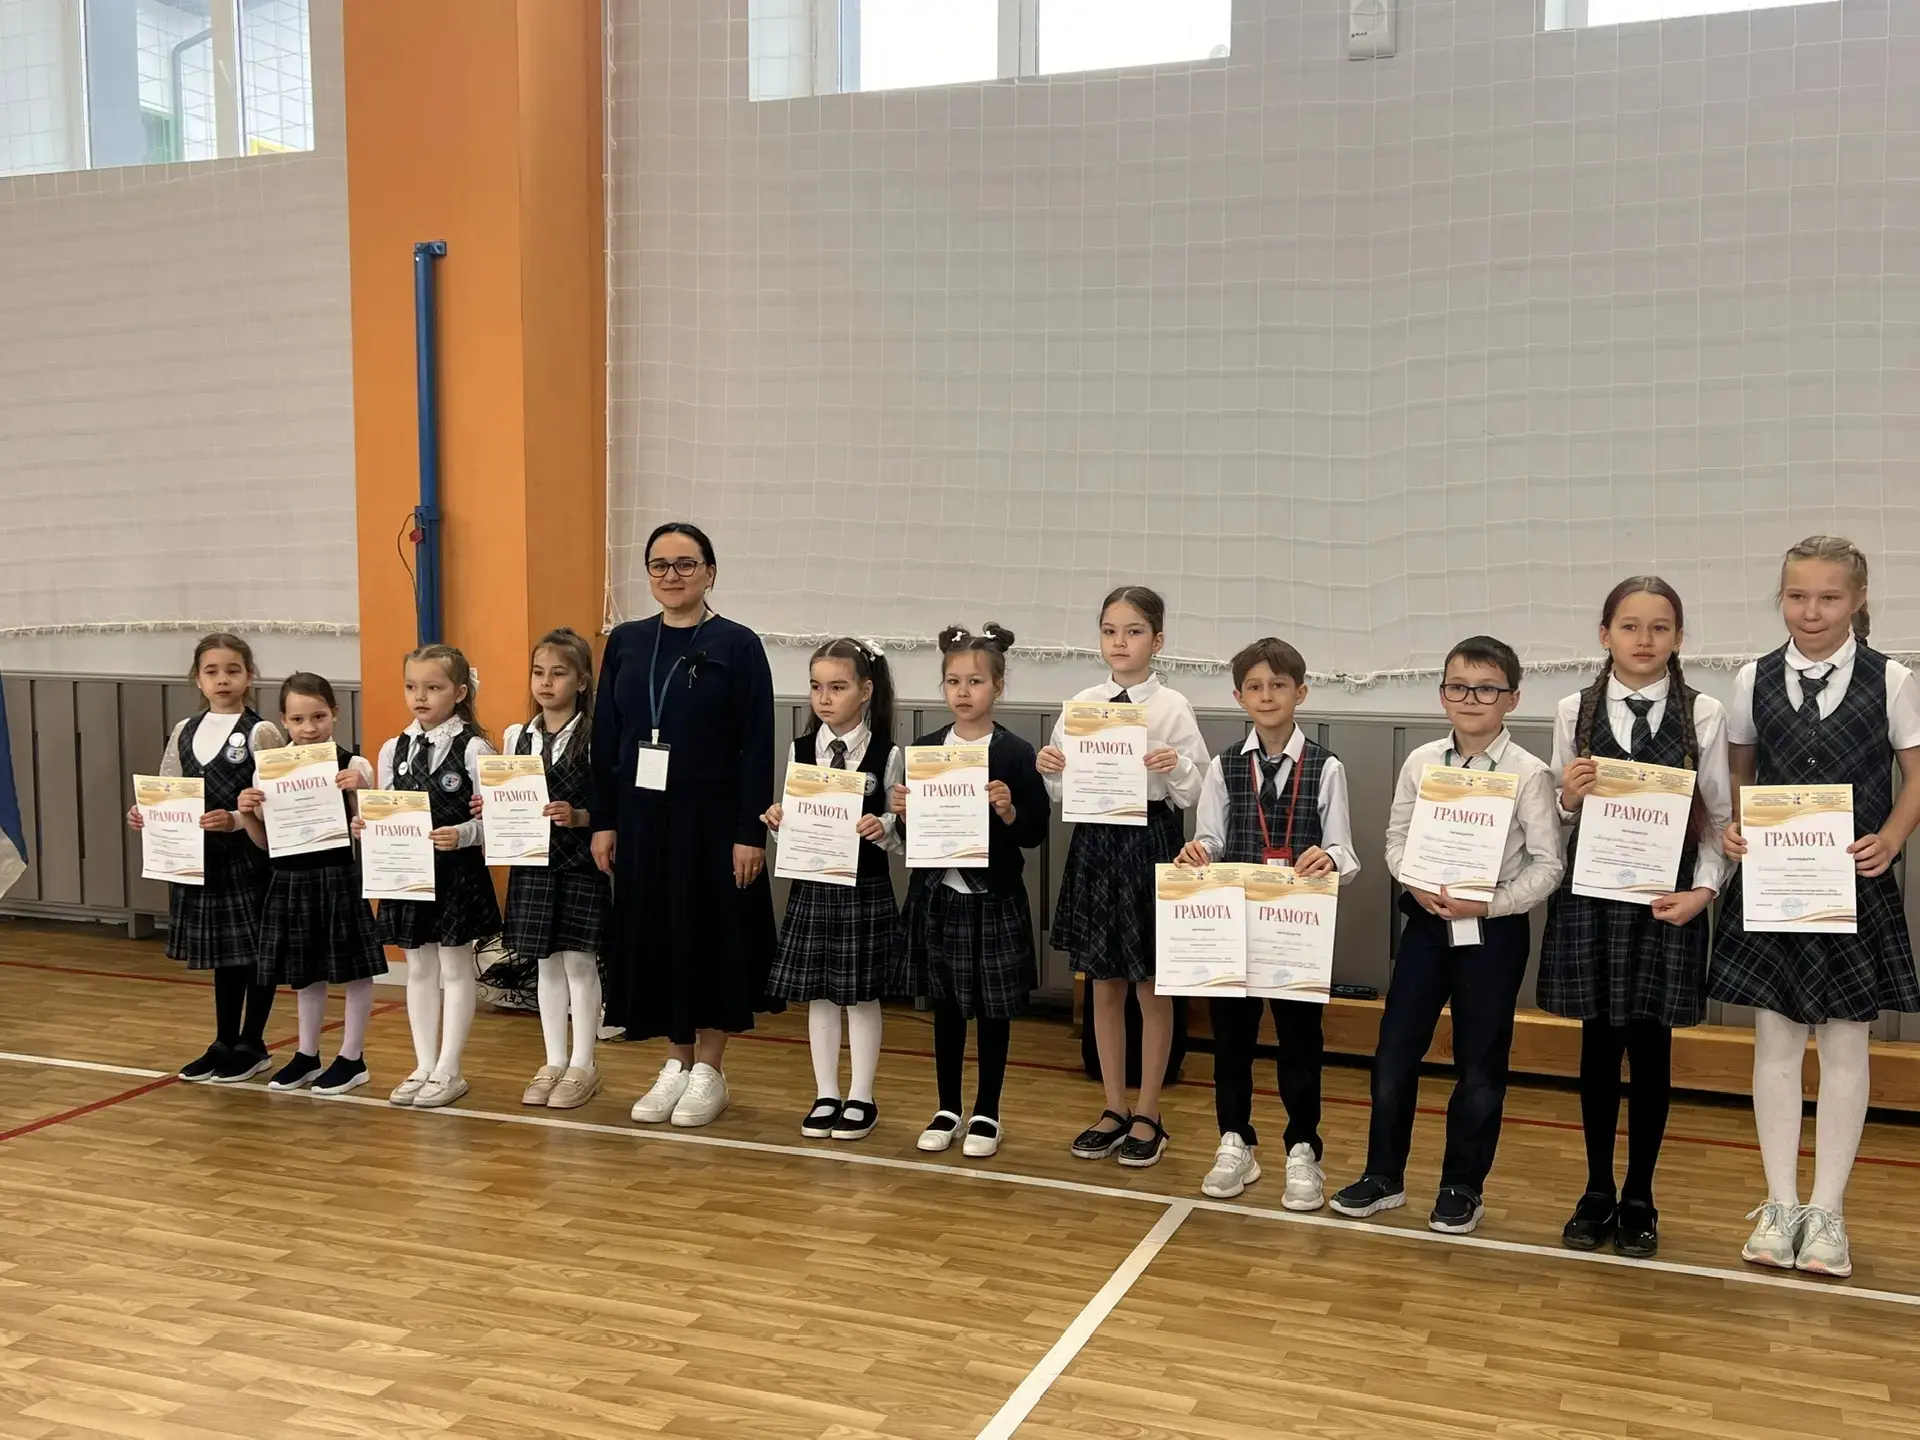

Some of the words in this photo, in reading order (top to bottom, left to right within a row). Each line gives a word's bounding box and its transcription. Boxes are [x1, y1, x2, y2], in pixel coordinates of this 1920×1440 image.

[1079, 741, 1134, 756] ГРАМОТА
[275, 776, 328, 794] ГРАМОТА
[923, 784, 976, 798] ГРАМОТА
[493, 791, 539, 802] ГРАМОТА
[149, 810, 193, 823] ГРАМОТА
[797, 802, 849, 821] ГРАМОТА
[1433, 807, 1494, 828] ГРАМОТА
[1603, 803, 1669, 826] ГРАМОТА
[375, 825, 422, 837] ГРАМОТА
[1764, 832, 1836, 847] ГРАМОТА
[1174, 905, 1232, 919] ГРАМОТА
[1259, 907, 1320, 927] ГРАМОТА
